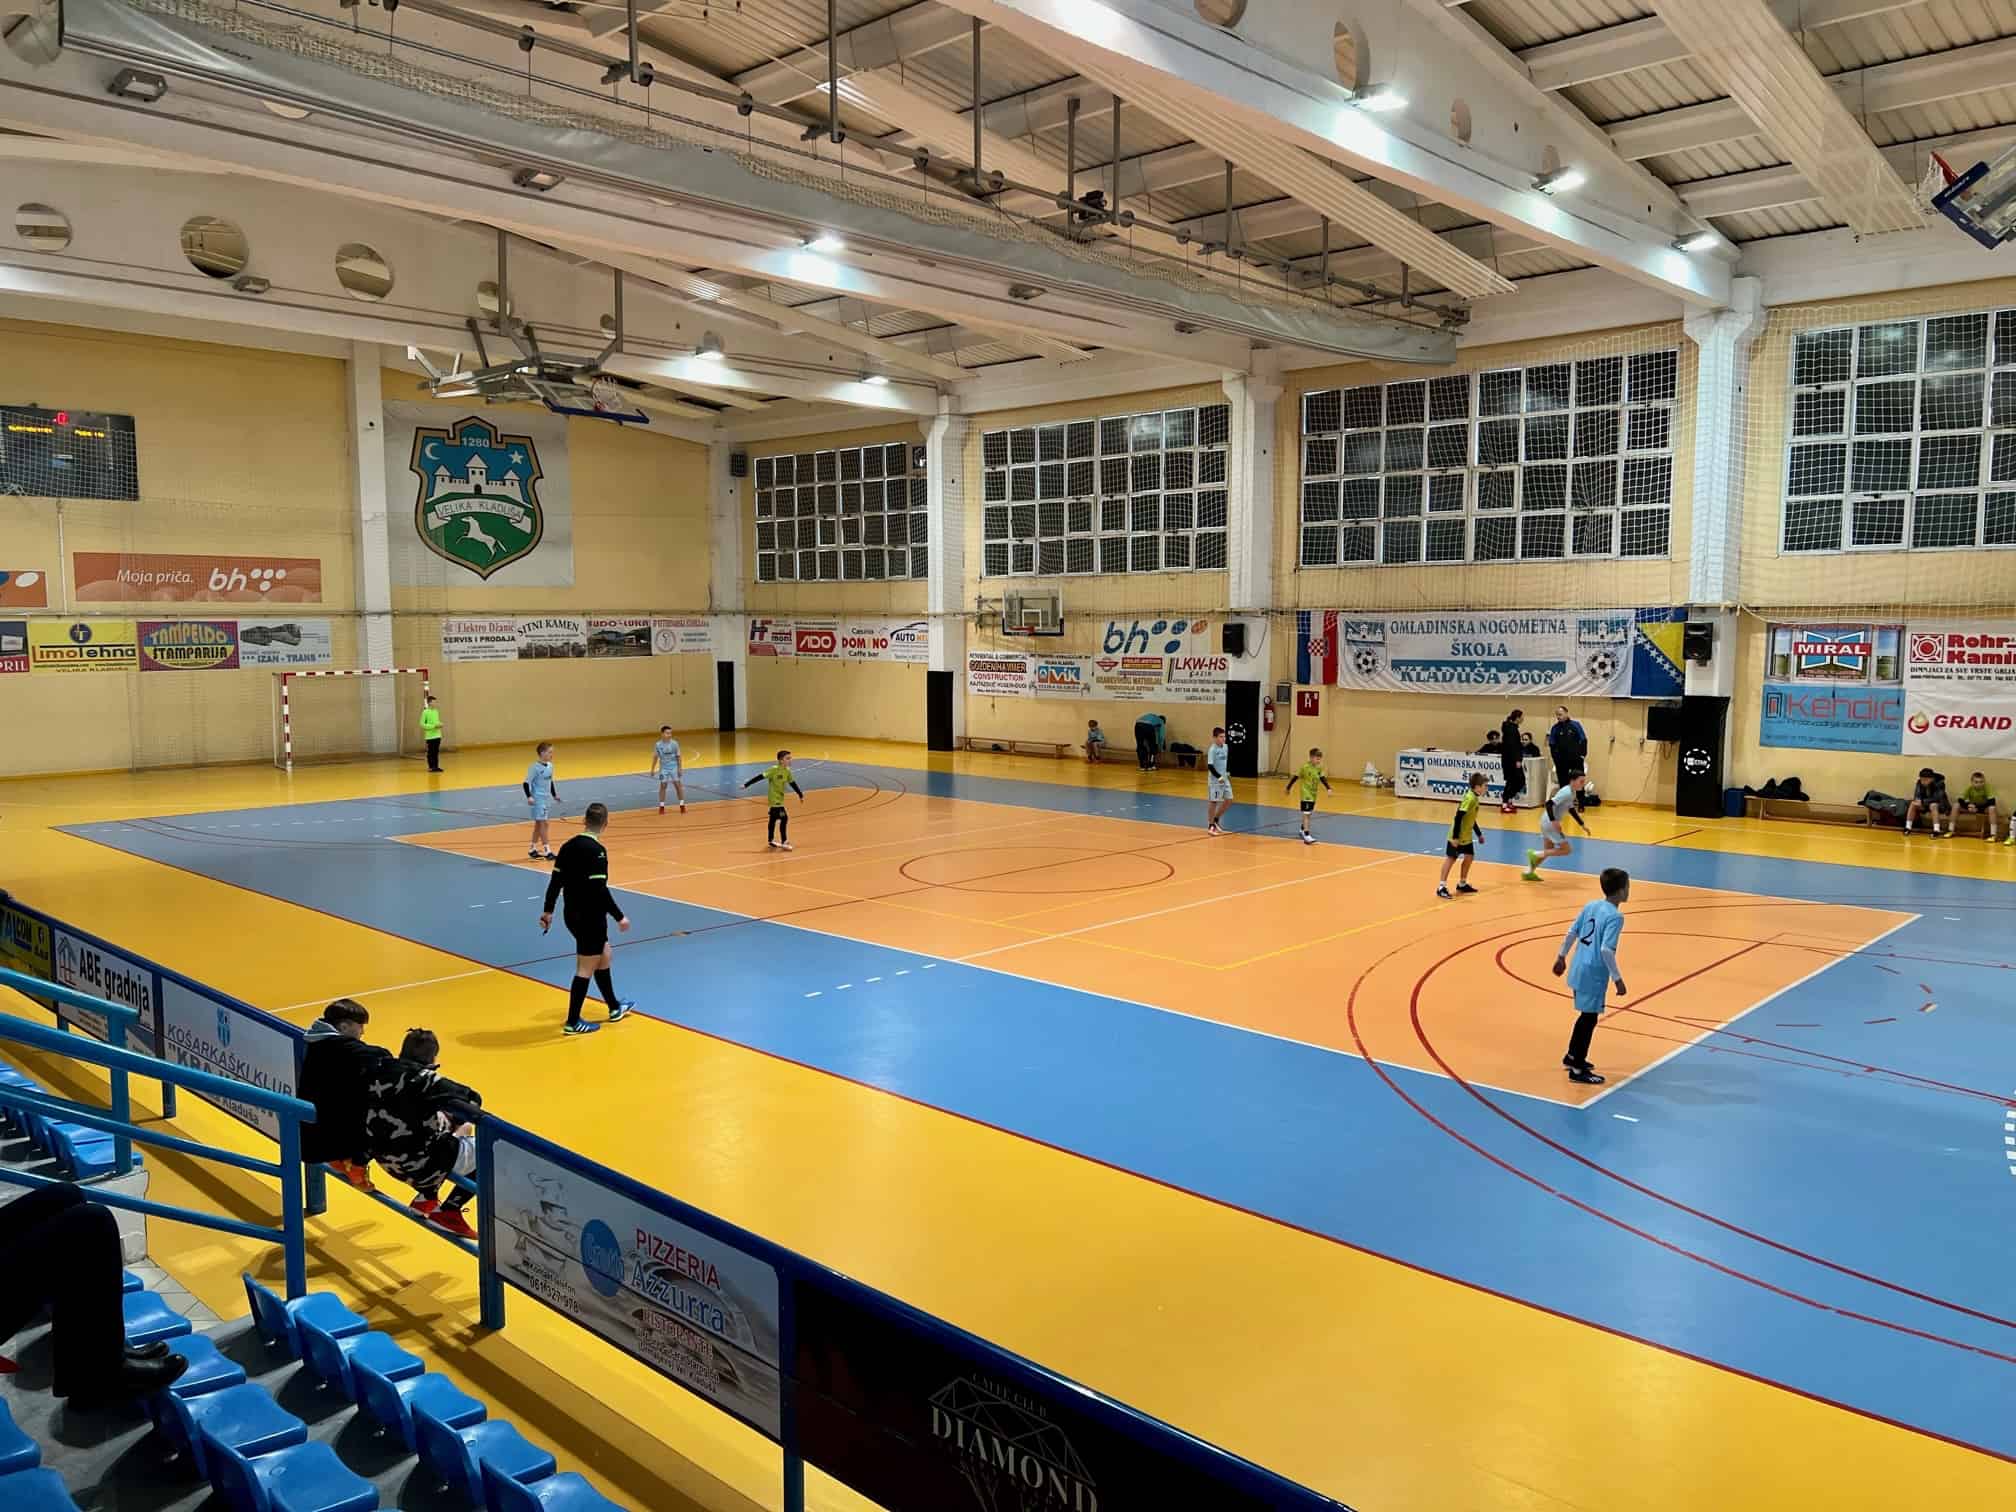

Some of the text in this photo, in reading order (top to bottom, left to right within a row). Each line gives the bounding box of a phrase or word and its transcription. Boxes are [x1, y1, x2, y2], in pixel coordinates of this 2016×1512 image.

[462, 437, 490, 448] 1280
[437, 501, 473, 514] VELIKA
[116, 569, 153, 584] Moja
[208, 567, 248, 592] bh
[517, 619, 580, 637] SITNI KAMEN
[1390, 619, 1568, 635] OMLADINSKA NOGOMETNA
[443, 636, 473, 644] SERVIS
[479, 635, 516, 643] PRODAJA
[800, 635, 832, 649] ADO
[895, 633, 916, 642] AUTO
[1103, 620, 1150, 654] bh
[1450, 639, 1509, 657] ŠKOLA
[1798, 644, 1867, 655] MIRAL
[1175, 657, 1227, 671] LKW-HS
[1934, 714, 2012, 730] GRAND
[1427, 757, 1477, 770] OMLADINSKA
[1580, 918, 1596, 947] 2
[80, 947, 150, 1017] ABE gradnja
[167, 1023, 251, 1079] KOŠARKAŠKI
[253, 1071, 293, 1097] KLUB
[635, 1228, 721, 1290] PIZZERIA
[631, 1260, 726, 1335] Azzurra
[931, 1405, 1098, 1512] DIAMOND
